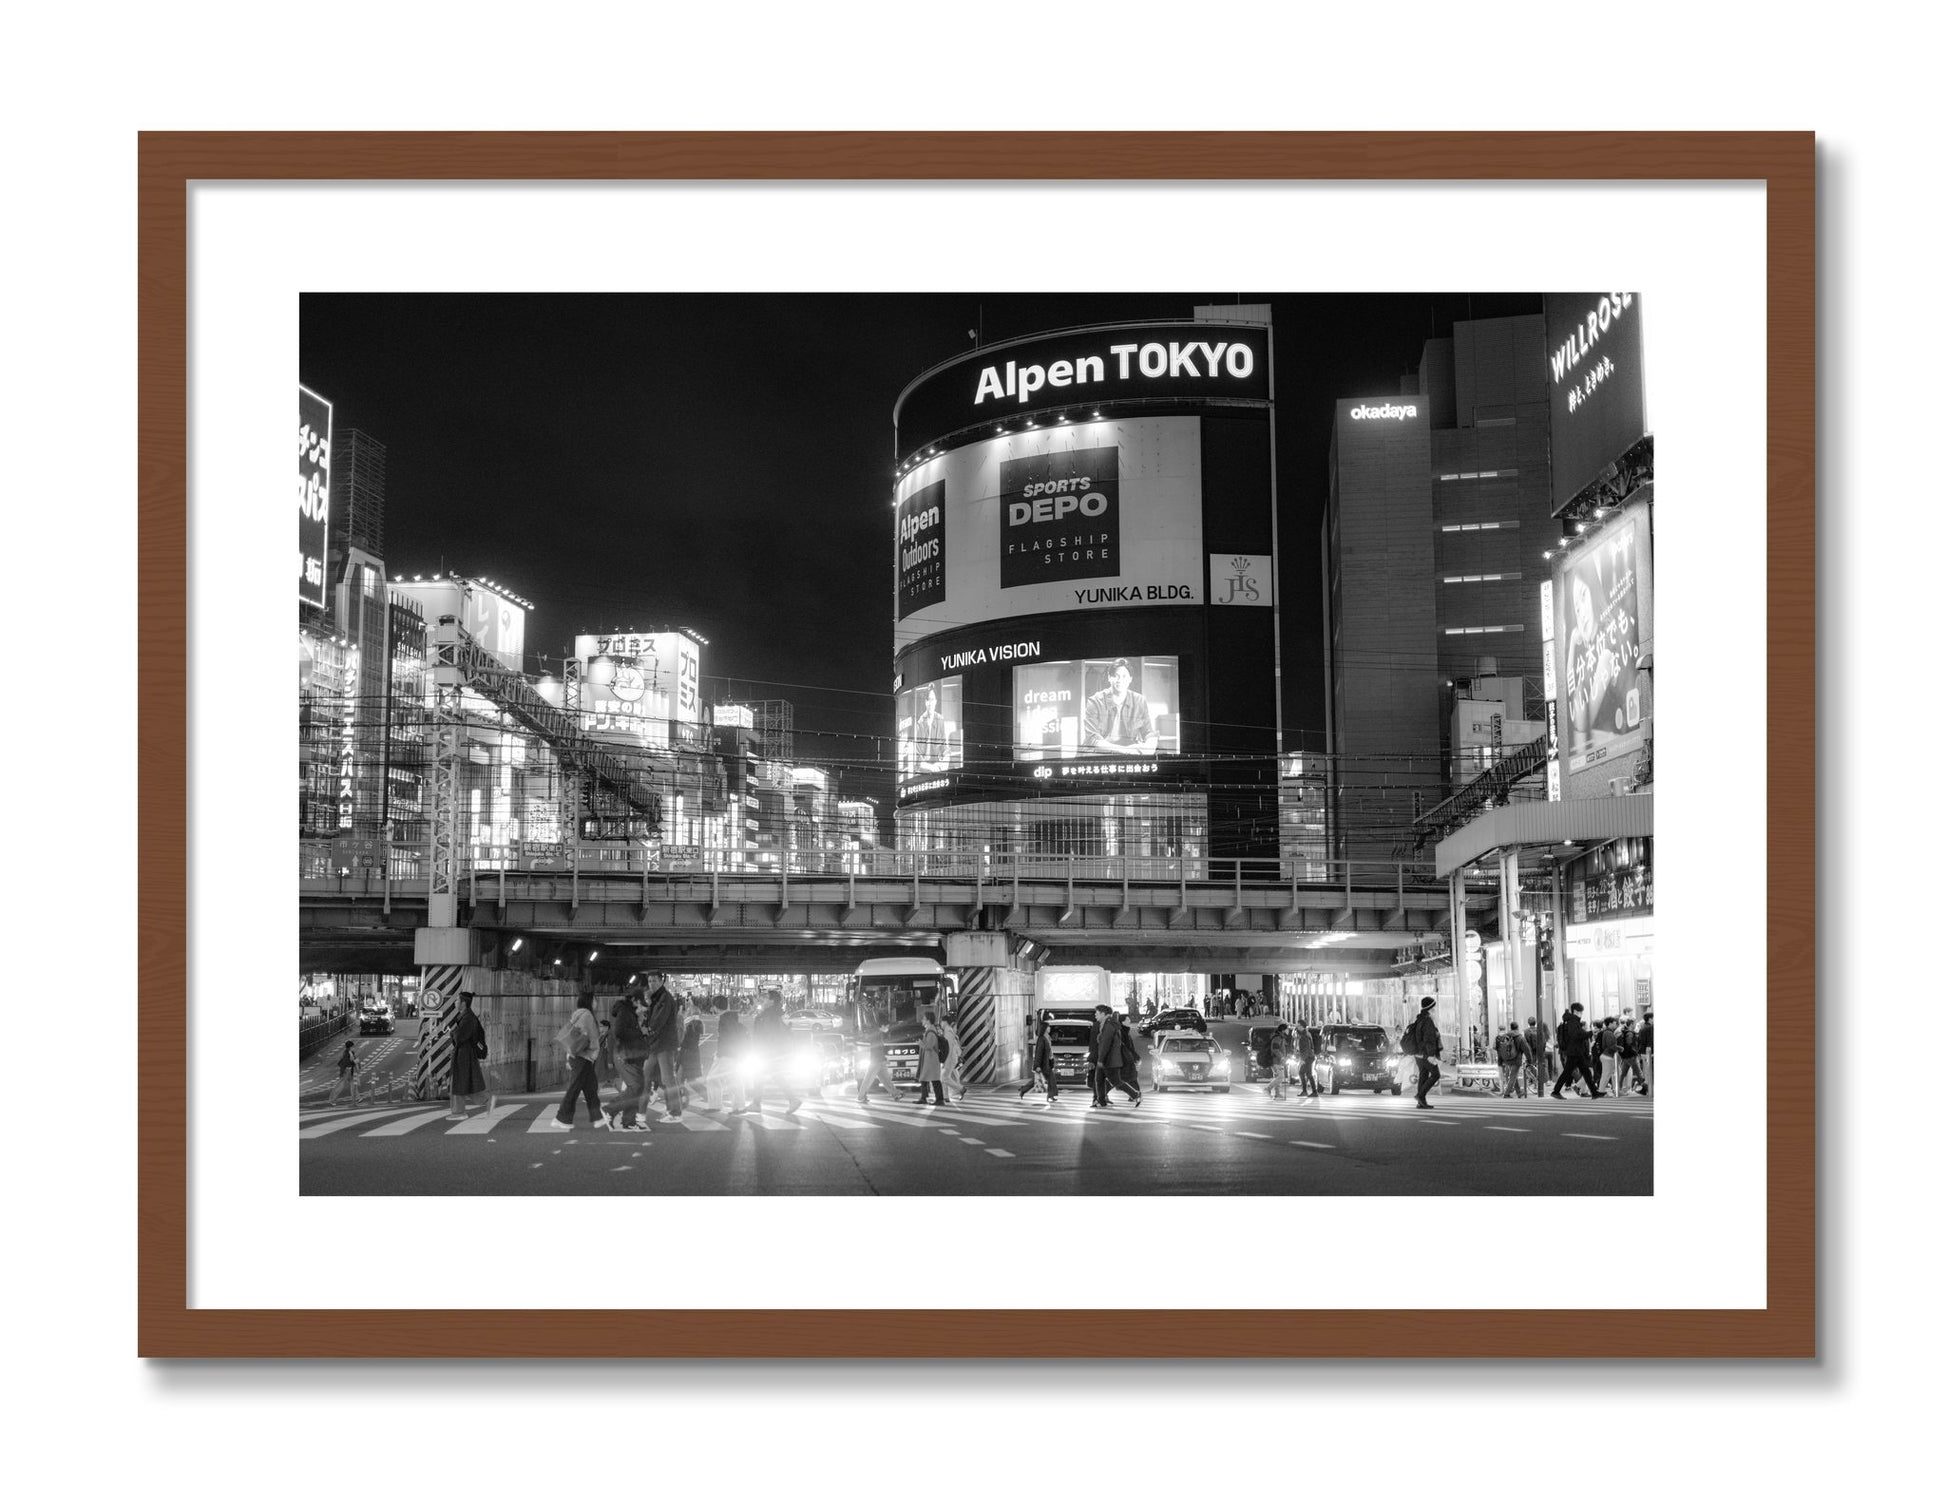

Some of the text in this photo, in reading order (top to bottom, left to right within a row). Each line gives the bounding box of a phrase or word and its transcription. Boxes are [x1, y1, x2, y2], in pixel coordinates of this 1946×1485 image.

[974, 342, 1254, 405] Alpen TOKYO
[1350, 403, 1417, 421] okadaya
[1023, 476, 1092, 498] SPORTS
[1009, 493, 1108, 527] DEPO
[900, 505, 940, 545] Alpen
[902, 538, 939, 572] Outdoors
[1008, 533, 1109, 555] FLAGSHIP
[1044, 548, 1109, 564] STORE
[1074, 584, 1195, 604] YUNIKA BLDG.
[596, 637, 656, 655] プロミス
[940, 640, 1041, 671] YUNIKA VISION
[1024, 689, 1072, 704] dream
[1034, 765, 1053, 779] dip
